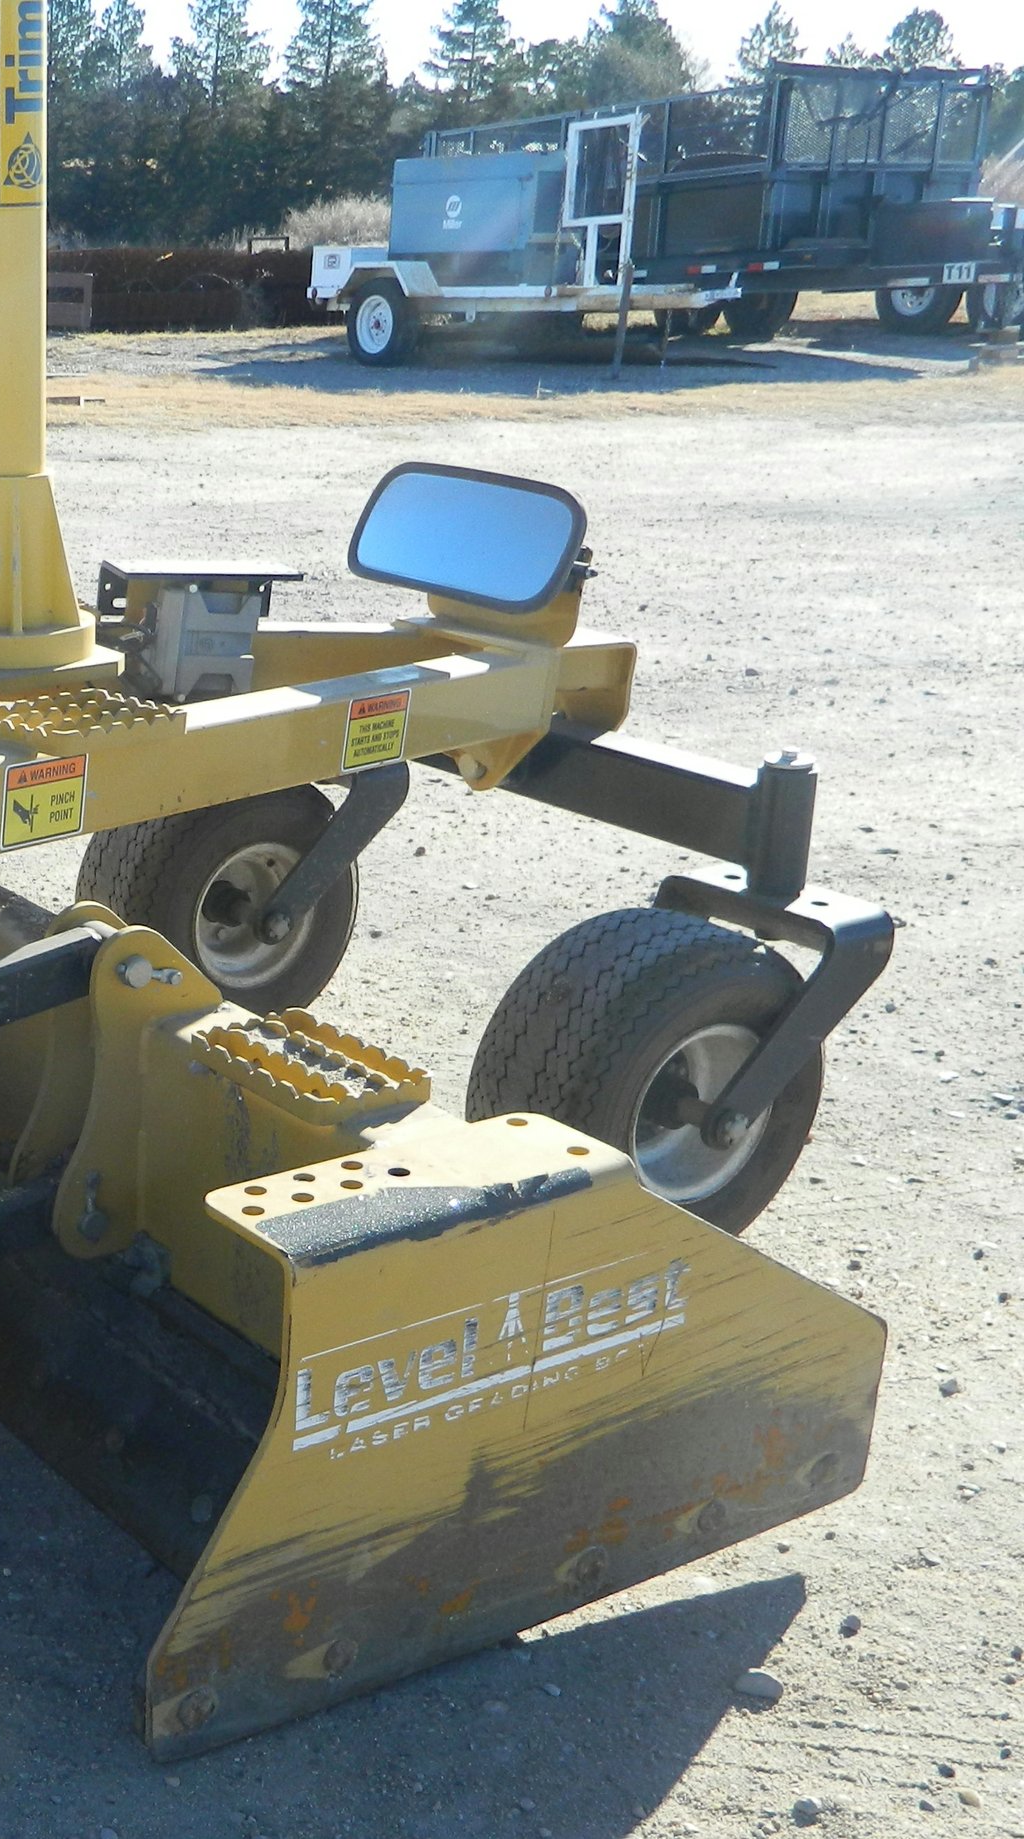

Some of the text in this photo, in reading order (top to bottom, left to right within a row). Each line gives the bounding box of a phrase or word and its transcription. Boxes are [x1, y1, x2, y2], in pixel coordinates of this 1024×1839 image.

[946, 265, 971, 279] T11
[367, 698, 401, 712] WARNING
[359, 719, 395, 733] THIS MACHINE
[351, 729, 400, 746] STARTS AND STOPS
[353, 742, 394, 757] AUTOMATICALLY
[30, 763, 76, 781] WARNING
[50, 790, 75, 806] PINCH
[49, 808, 74, 823] POINT
[295, 1317, 479, 1431] Level
